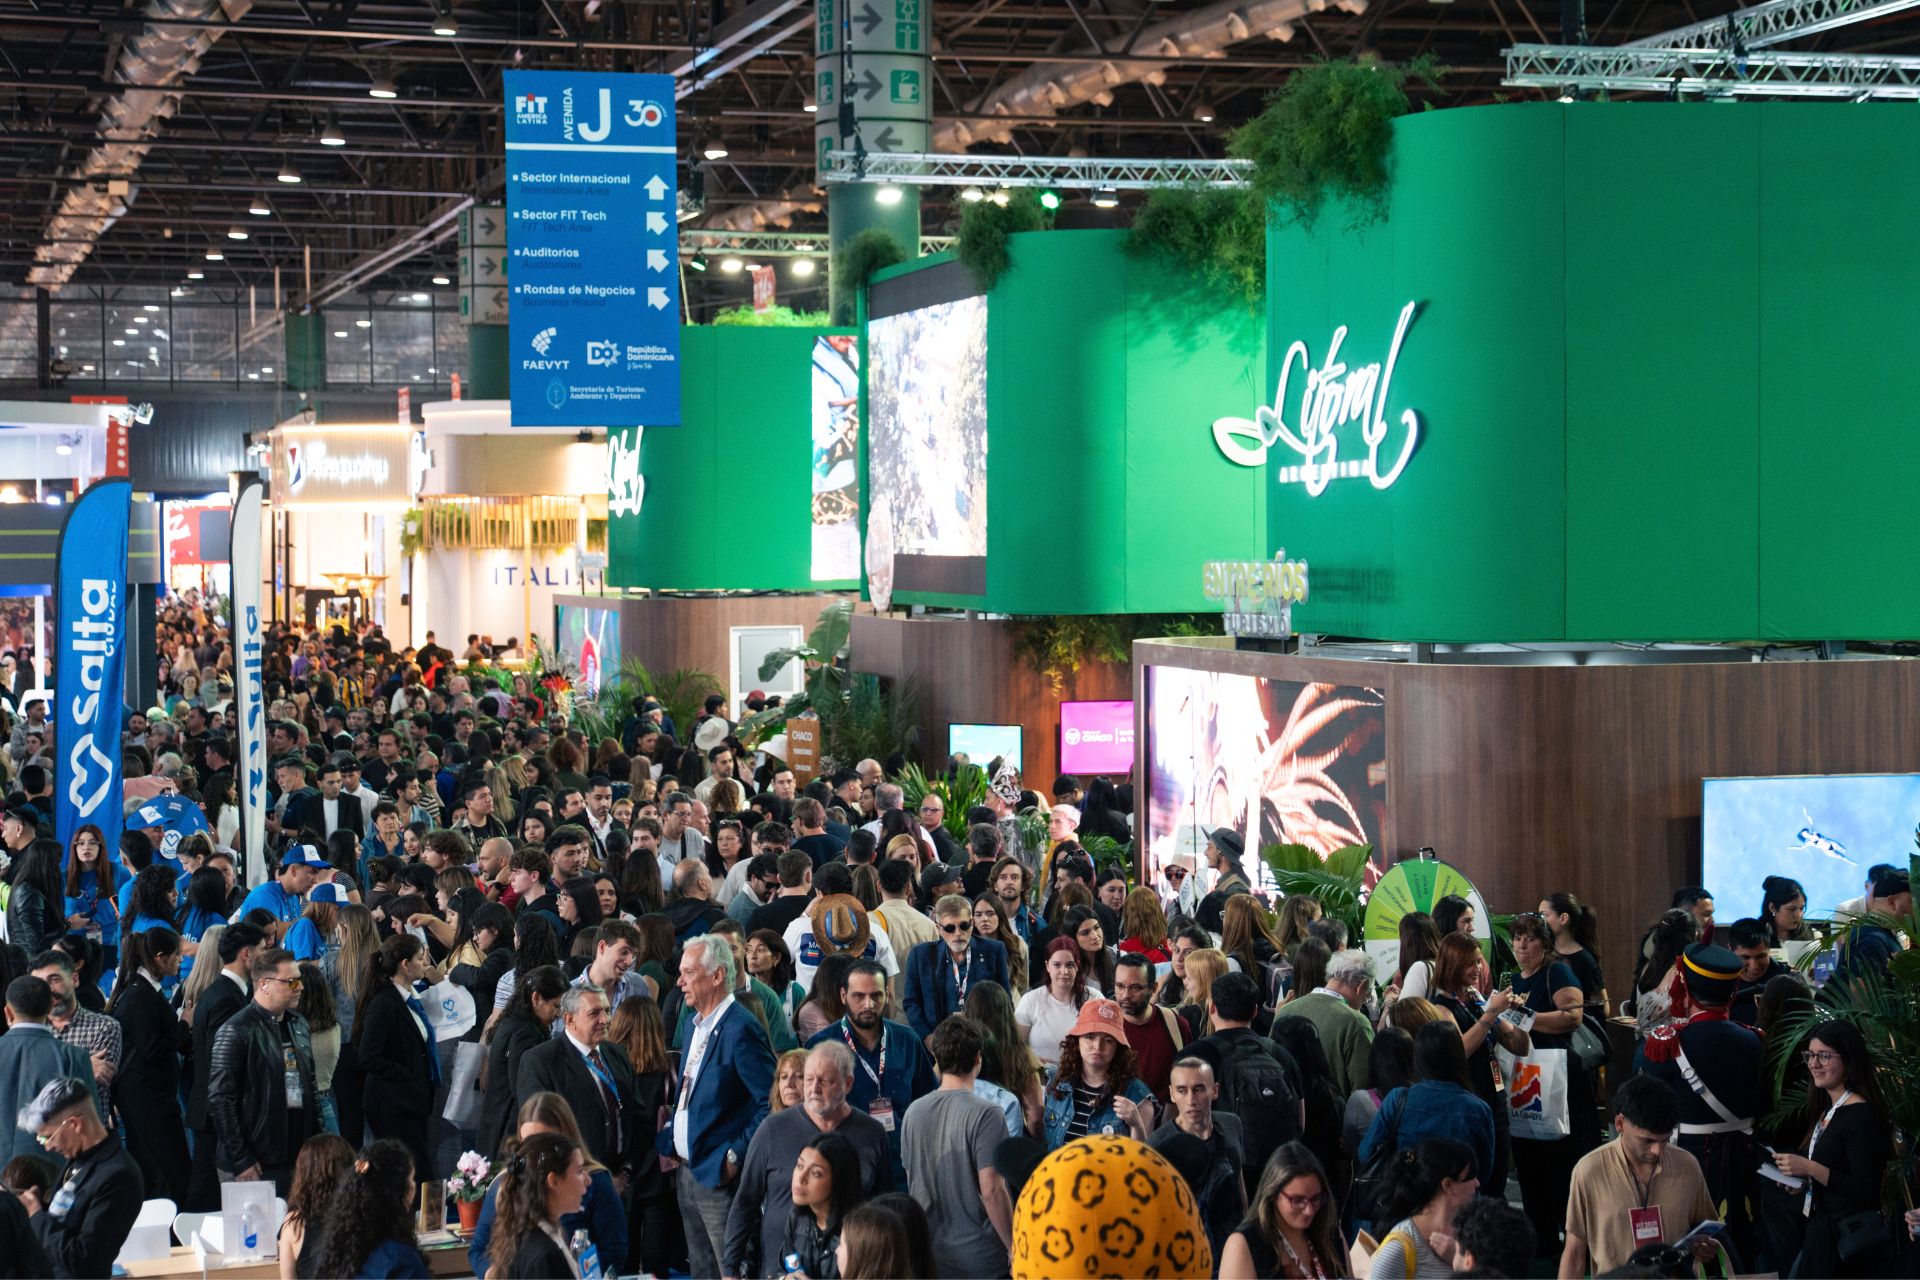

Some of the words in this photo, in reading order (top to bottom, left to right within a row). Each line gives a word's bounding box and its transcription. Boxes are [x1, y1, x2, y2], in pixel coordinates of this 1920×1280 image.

[563, 88, 574, 141] AVENIDA
[578, 88, 611, 142] J
[521, 172, 557, 182] Sector
[560, 173, 630, 184] Internacional
[520, 185, 583, 195] International
[585, 186, 610, 196] Area
[522, 210, 557, 220] Sector
[561, 210, 578, 220] FIT
[581, 211, 607, 221] Tech
[521, 222, 537, 232] FIT
[543, 222, 567, 232] Tech
[569, 223, 593, 233] Area
[522, 247, 579, 258] Auditorios
[521, 259, 582, 269] Auditoriums
[523, 284, 565, 295] Rondas
[568, 285, 581, 295] de
[584, 285, 635, 297] Negocios
[627, 346, 667, 354] República
[523, 360, 569, 370] FAEVYT
[610, 393, 641, 401] Deportes
[72, 578, 110, 725] Salta
